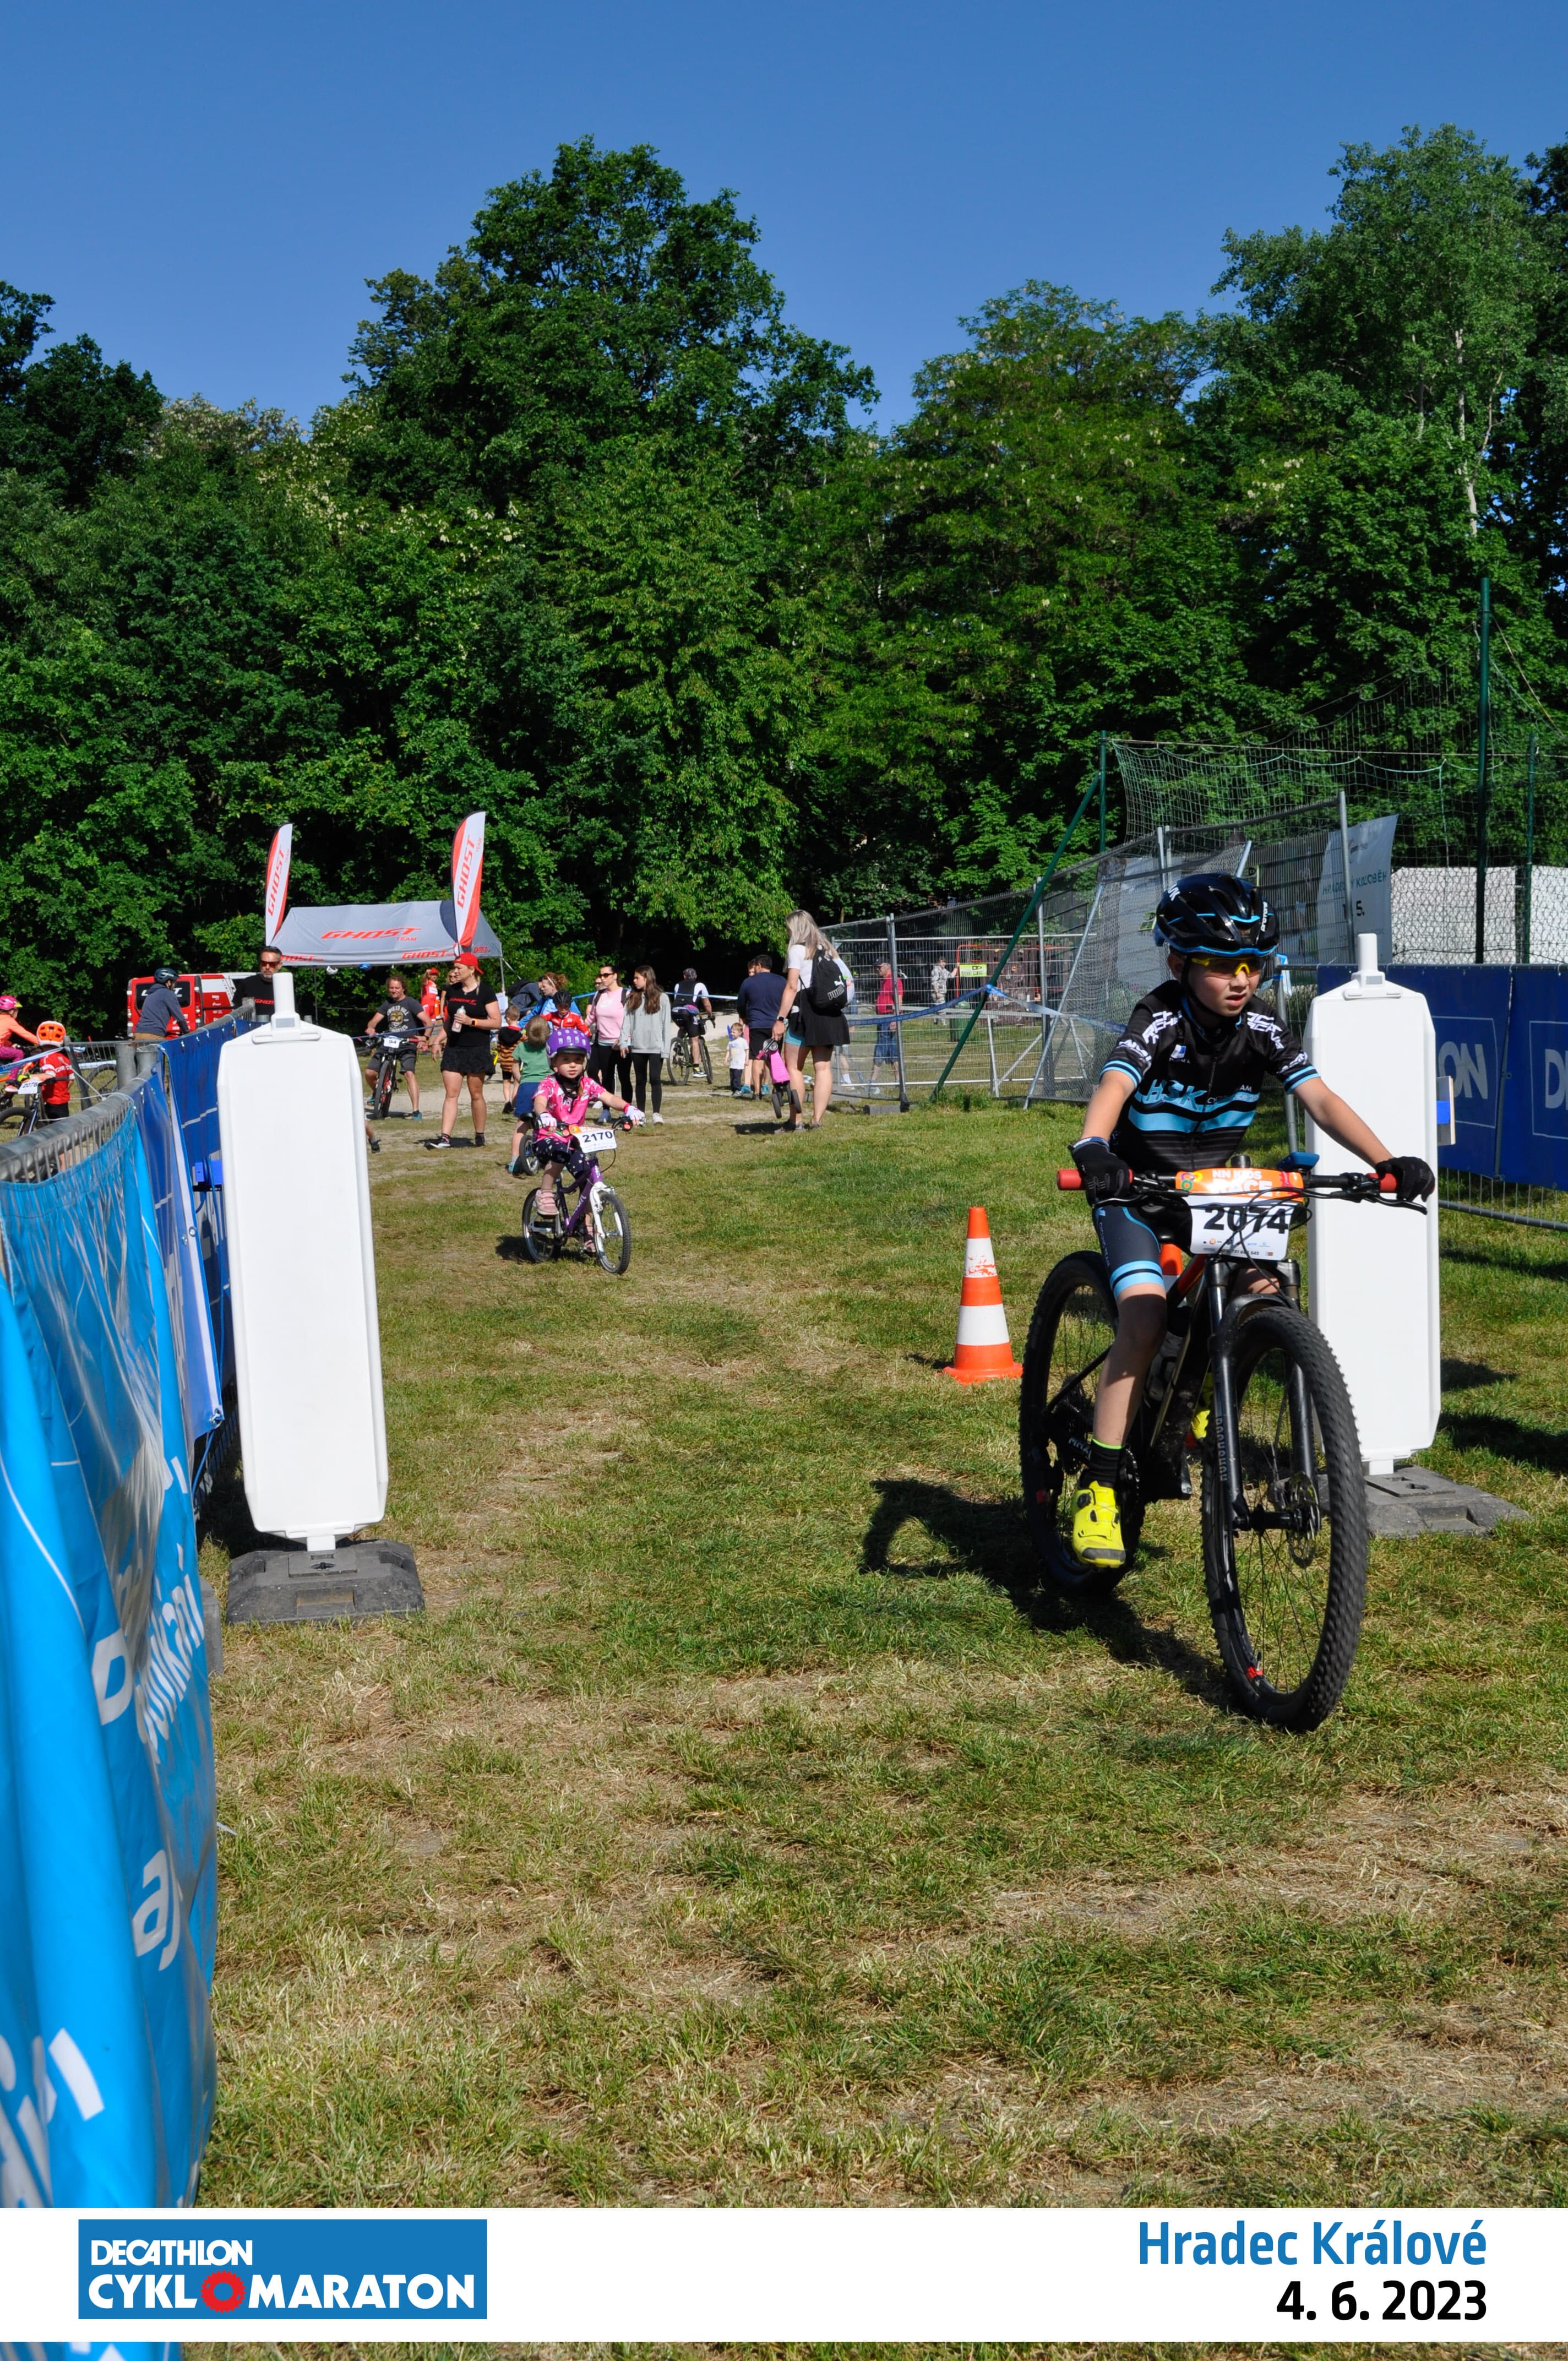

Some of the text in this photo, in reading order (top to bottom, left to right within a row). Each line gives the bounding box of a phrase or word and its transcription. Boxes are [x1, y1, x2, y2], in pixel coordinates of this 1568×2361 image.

[456, 835, 475, 908] GHOST
[268, 845, 285, 916] GHOST
[321, 927, 422, 939] GHOST
[401, 950, 448, 959] GHOST
[582, 1131, 613, 1143] 2170
[1212, 1169, 1231, 1178] NN
[1204, 1204, 1289, 1234] 2074
